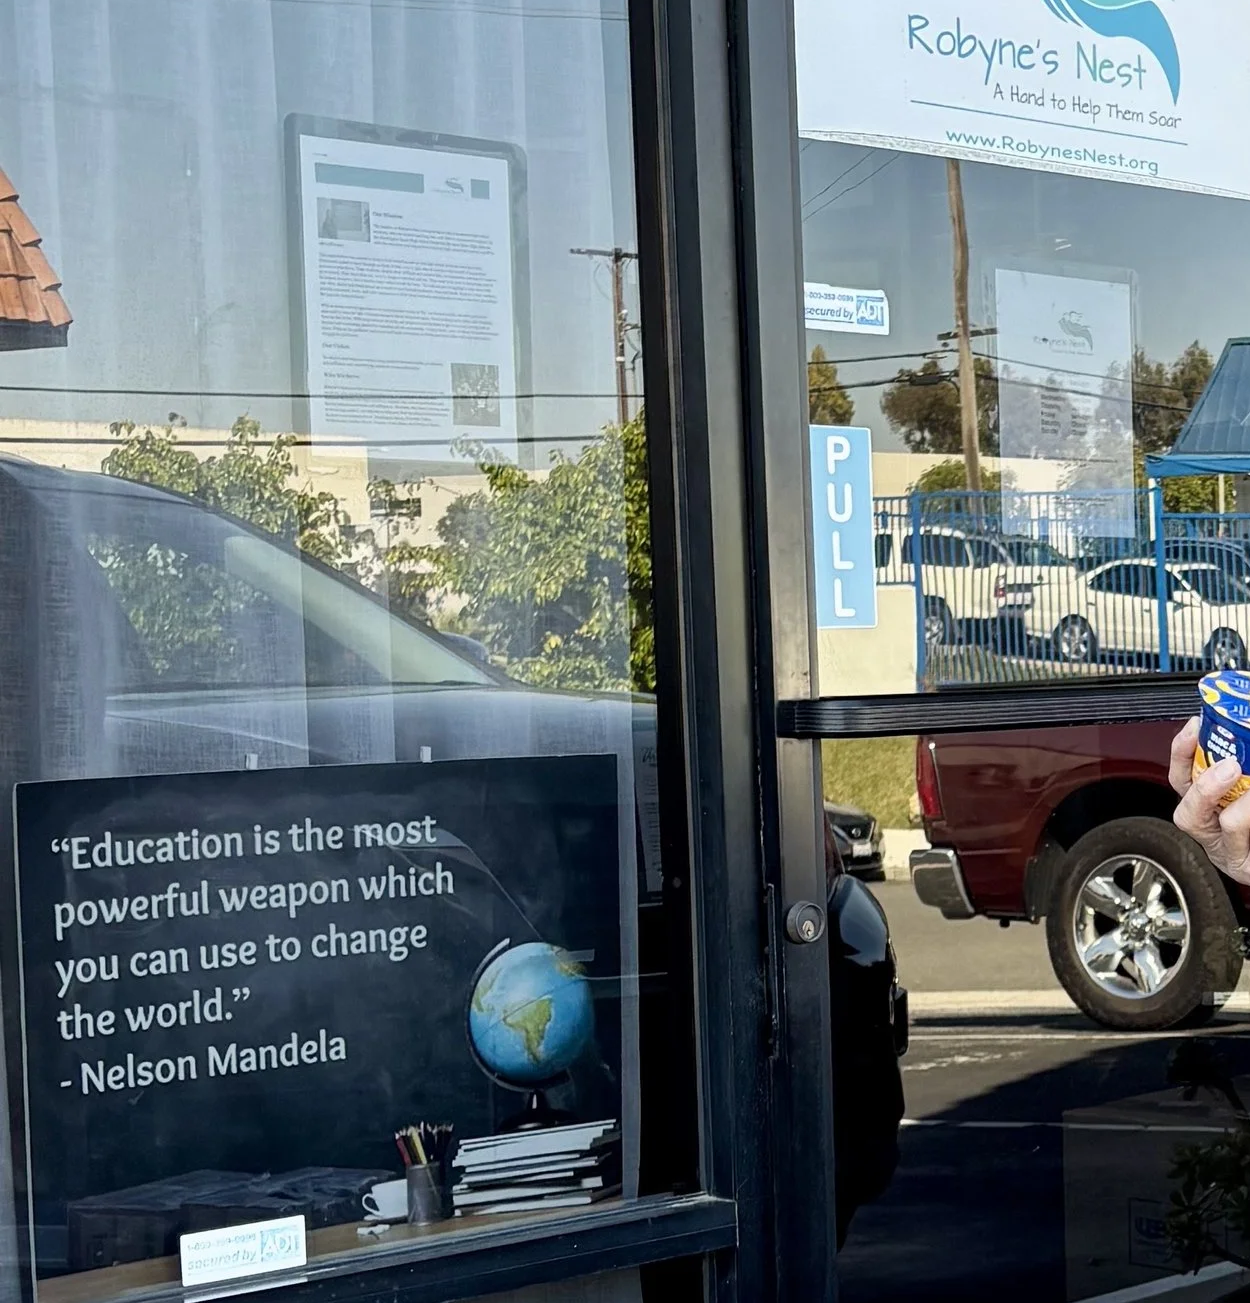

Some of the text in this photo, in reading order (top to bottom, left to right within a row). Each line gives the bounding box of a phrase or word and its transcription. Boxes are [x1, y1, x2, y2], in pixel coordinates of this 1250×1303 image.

[907, 13, 1147, 91] Robyne's Nest
[993, 83, 1182, 130] A Hand to Help Them Soar
[945, 128, 1159, 177] www.RobynesNest.org
[843, 307, 854, 321] by
[857, 300, 884, 322] ADT
[825, 435, 857, 619] PULL
[51, 814, 438, 871] “Education is the most
[53, 862, 455, 941] powerful weapon which
[54, 920, 429, 999] you can use to change
[56, 1001, 117, 1041] the
[80, 1050, 198, 1096] Nelson
[207, 1030, 348, 1080] Mandela
[187, 1248, 257, 1271] secured by
